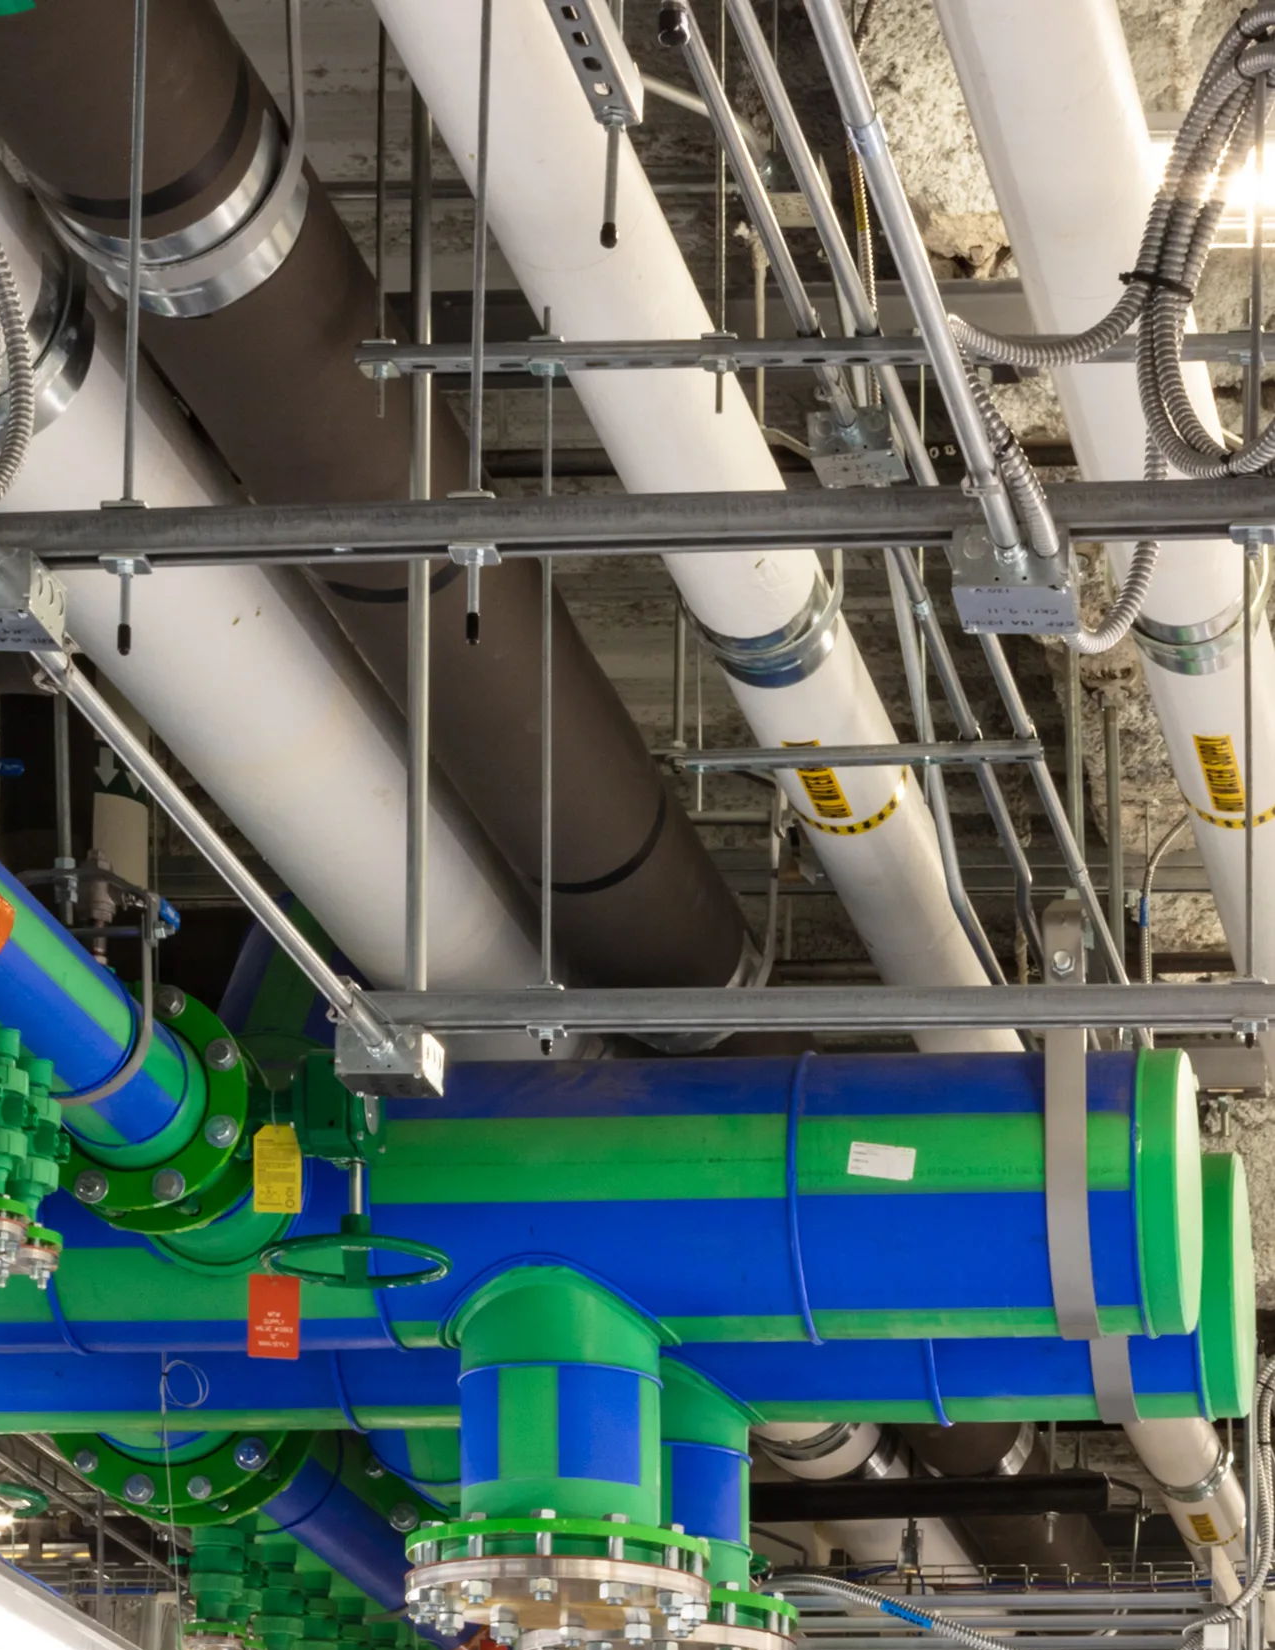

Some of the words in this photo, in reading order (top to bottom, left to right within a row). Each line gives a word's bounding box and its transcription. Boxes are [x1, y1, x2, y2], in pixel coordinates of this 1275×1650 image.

[1195, 735, 1234, 766] SUPPLY
[802, 774, 841, 801] WATER
[1205, 768, 1241, 795] WATER
[814, 802, 850, 819] HOT
[1213, 795, 1245, 812] HOT
